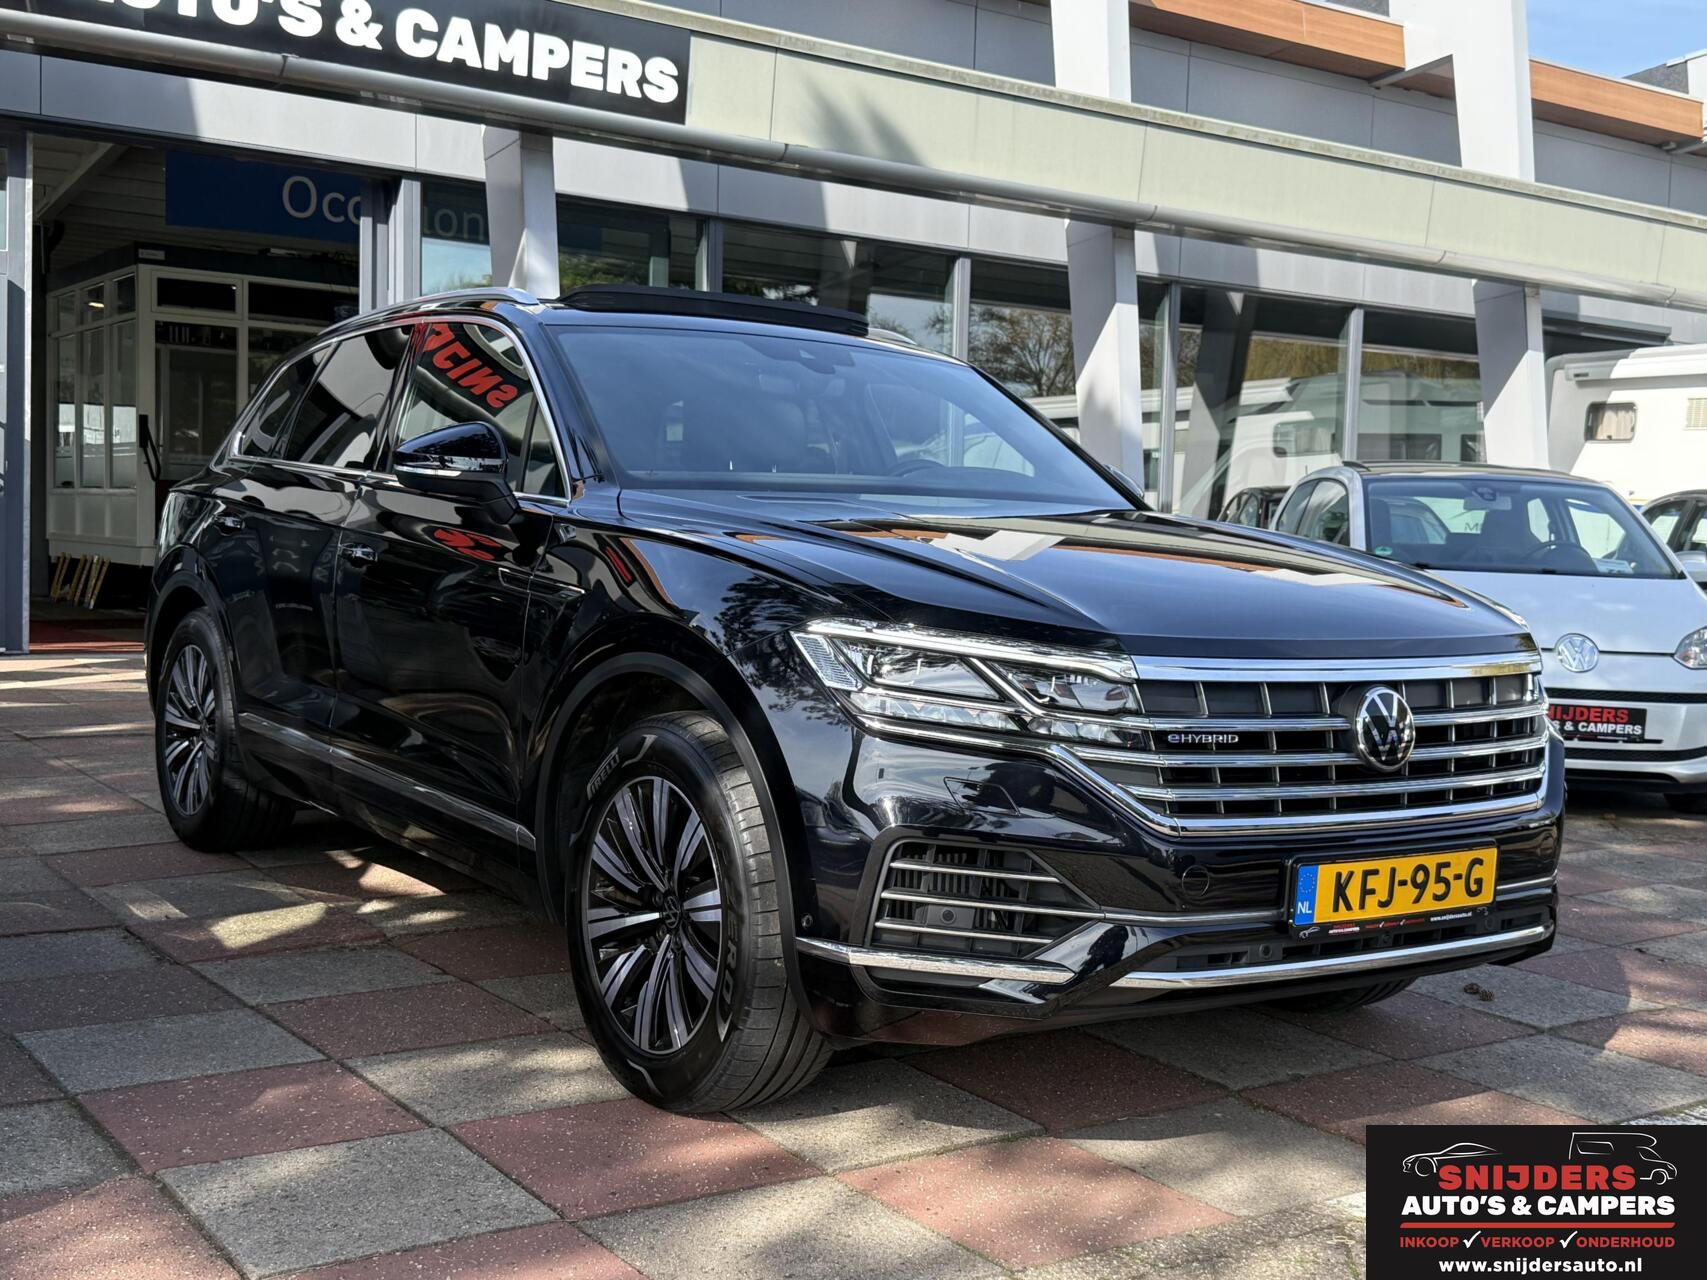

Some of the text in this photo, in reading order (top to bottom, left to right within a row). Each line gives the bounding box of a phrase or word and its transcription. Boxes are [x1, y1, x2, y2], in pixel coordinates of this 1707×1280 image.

[335, 0, 384, 50] &
[395, 9, 680, 105] CAMPERS
[1548, 705, 1629, 723] IJDERS
[1563, 721, 1575, 732] &
[1578, 722, 1642, 735] CAMPERS
[1168, 733, 1239, 744] eHYBRID
[1332, 857, 1484, 913] KFJ-95-G
[1297, 902, 1313, 915] NL
